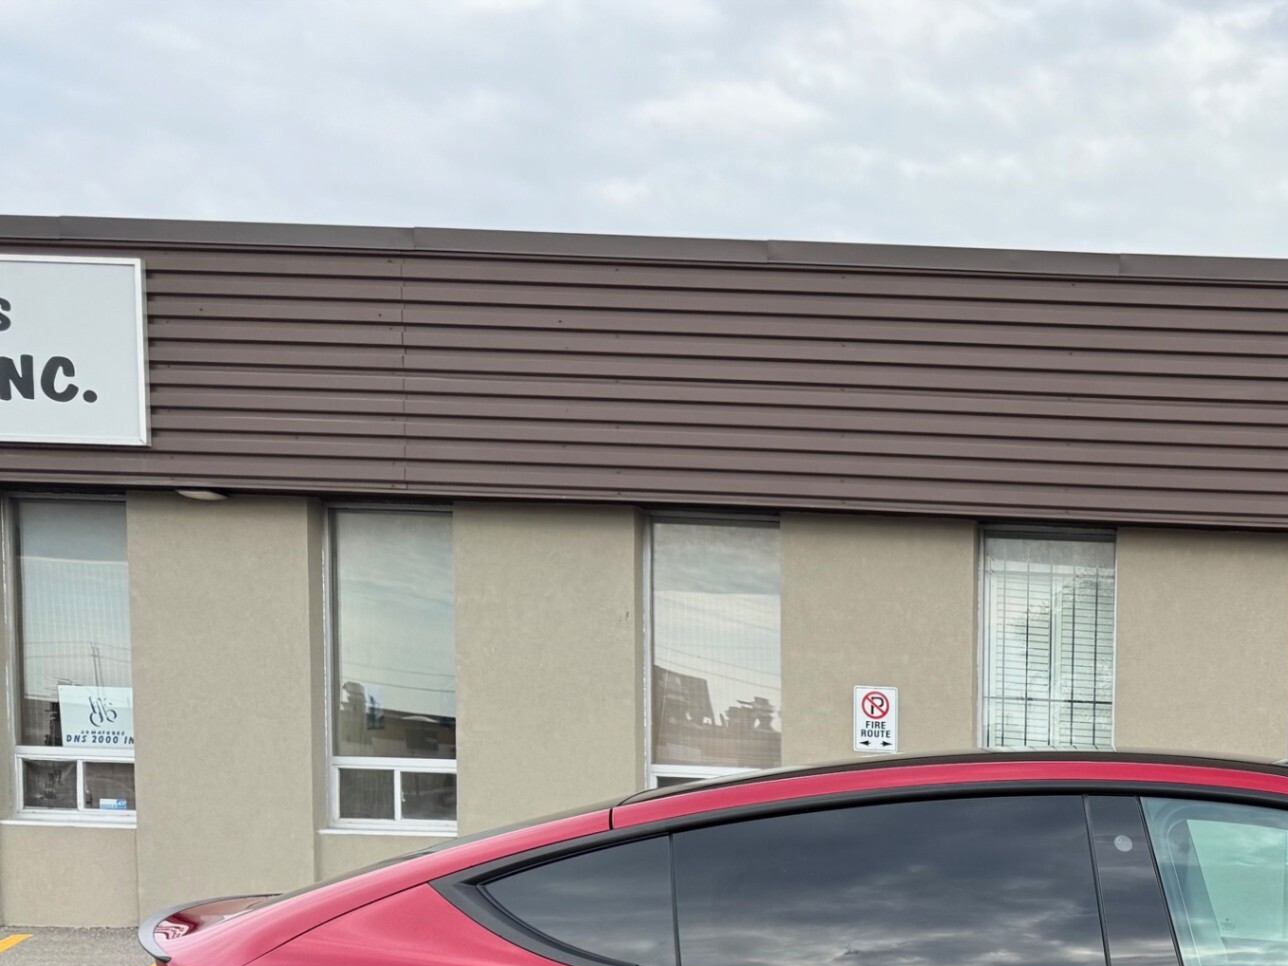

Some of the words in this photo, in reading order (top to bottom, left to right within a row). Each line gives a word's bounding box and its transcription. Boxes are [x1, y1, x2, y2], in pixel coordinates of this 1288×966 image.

[865, 721, 886, 729] FIRE
[861, 729, 891, 738] ROUTE
[66, 734, 88, 743] DNS
[92, 735, 119, 744] 2000
